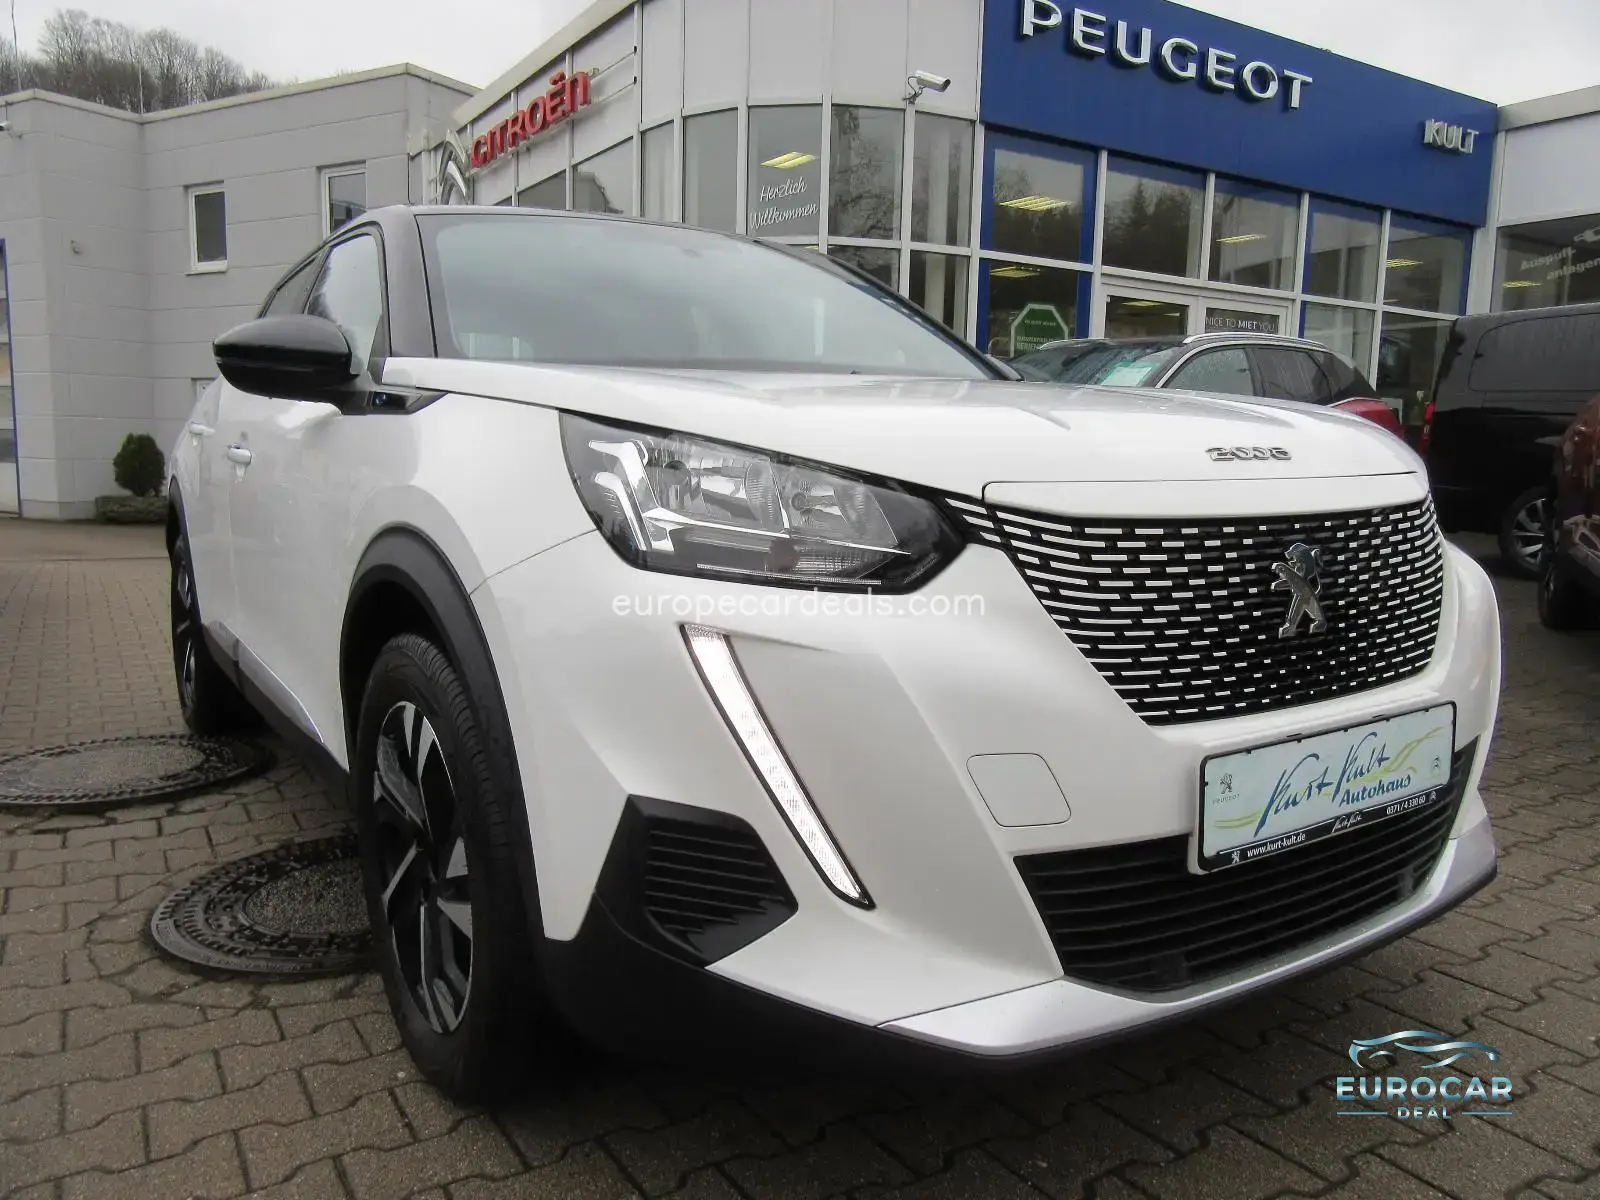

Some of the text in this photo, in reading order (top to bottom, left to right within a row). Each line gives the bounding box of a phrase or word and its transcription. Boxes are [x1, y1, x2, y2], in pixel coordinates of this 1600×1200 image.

[1021, 0, 1313, 109] PEUGEOT
[1424, 118, 1480, 154] KULT
[759, 175, 808, 202] Herzlich
[750, 203, 819, 230] Willkommen
[1205, 316, 1224, 327] NICE
[1226, 318, 1236, 328] TO
[1237, 319, 1258, 330] MIET
[1254, 731, 1391, 838] Kurt Kult
[1338, 774, 1412, 808] Autohaus
[1247, 832, 1306, 858] www.kurt-kult.de
